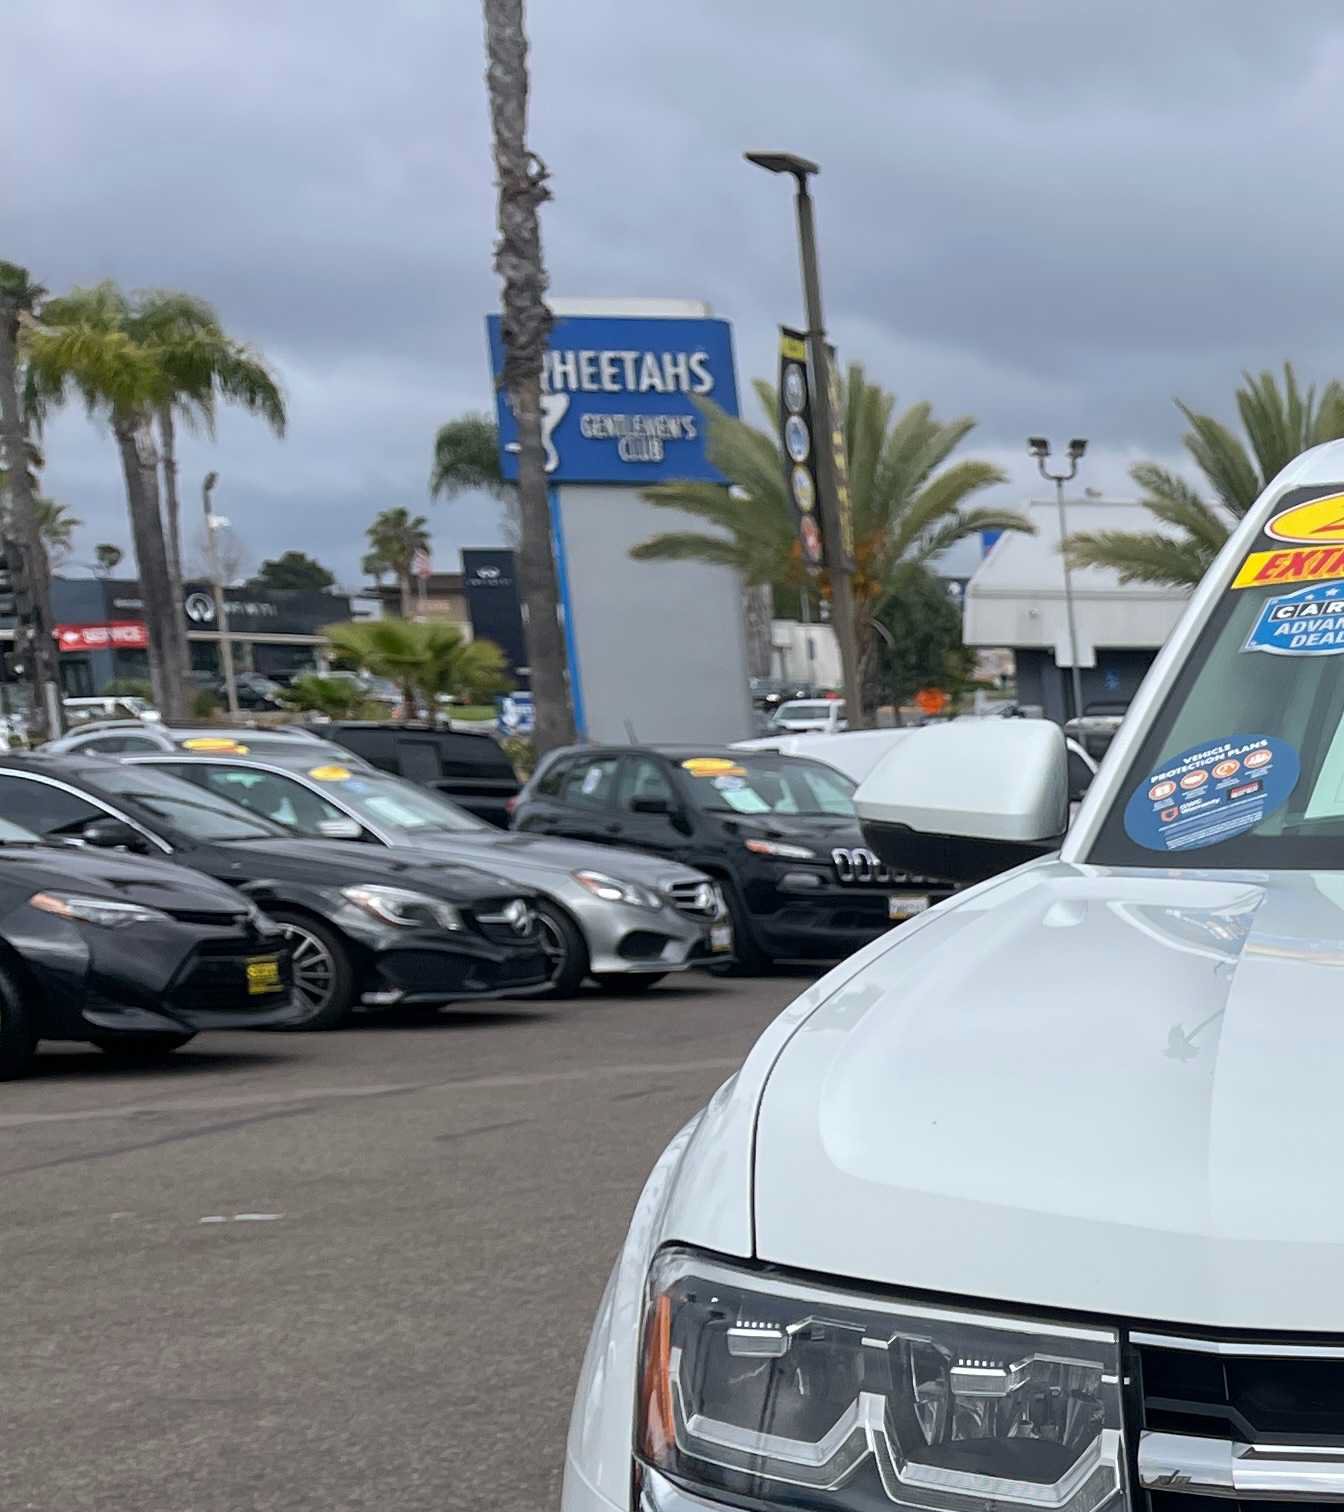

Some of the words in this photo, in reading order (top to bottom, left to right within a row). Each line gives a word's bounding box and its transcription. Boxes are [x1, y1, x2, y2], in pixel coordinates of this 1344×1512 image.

[618, 438, 664, 462] CLUB
[1150, 754, 1226, 784] PROTECTION
[1227, 739, 1269, 759] PLANS
